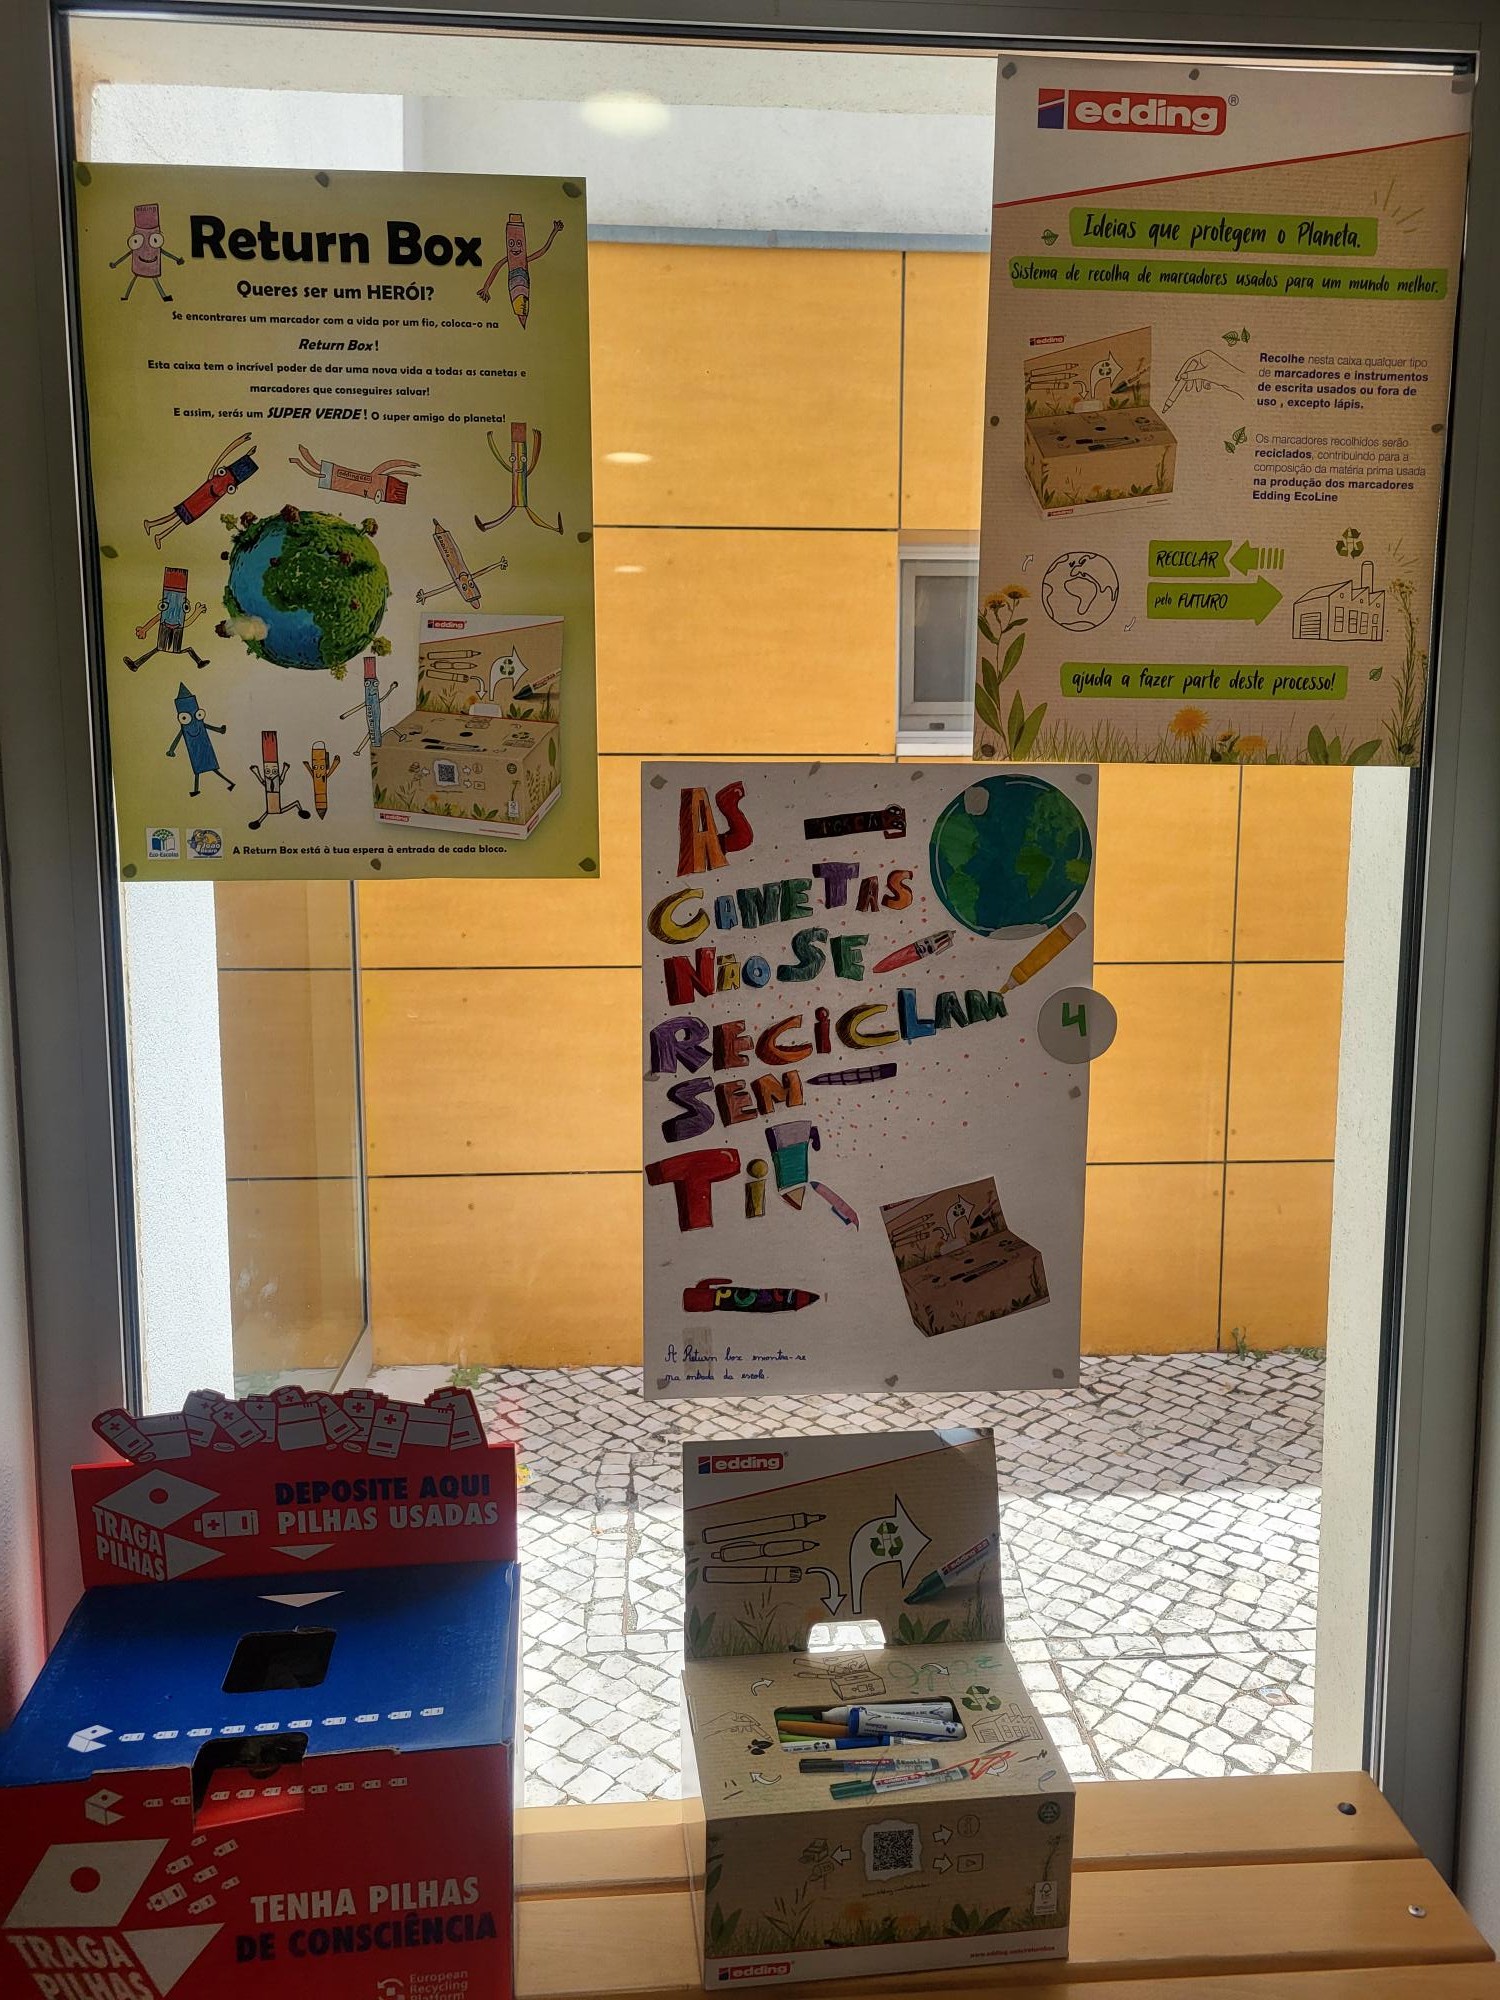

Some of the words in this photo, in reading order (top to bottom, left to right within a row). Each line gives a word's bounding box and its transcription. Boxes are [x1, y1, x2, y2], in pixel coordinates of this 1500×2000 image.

[1074, 97, 1218, 133] edding
[190, 215, 370, 263] Return
[386, 220, 483, 267] Box
[1083, 212, 1137, 239] Ideias
[1148, 224, 1180, 246] que
[1190, 223, 1267, 252] protegem
[1277, 231, 1286, 245] o
[1297, 221, 1361, 248] Planeta.
[1010, 262, 1058, 281] Sistema
[1065, 263, 1079, 281] de
[1087, 264, 1130, 283] recolha
[1137, 265, 1151, 284] de
[1159, 266, 1228, 286] marcadores
[1235, 269, 1278, 288] usados
[1284, 273, 1314, 293] para
[1321, 274, 1341, 290] um
[1348, 272, 1390, 292] mundo
[1396, 272, 1439, 294] melhor.
[236, 280, 298, 299] Queres
[303, 286, 328, 298] ser
[333, 288, 361, 299] um
[367, 281, 434, 301] HERÓI?
[172, 311, 183, 321] Se
[186, 312, 247, 323] encontrares
[250, 314, 267, 323] um
[270, 313, 320, 325] marcador
[323, 317, 344, 326] com
[356, 316, 380, 326] vida
[382, 318, 400, 330] por
[402, 319, 419, 327] um
[422, 317, 438, 329] fio,
[441, 318, 483, 329] coloca-o
[486, 320, 499, 329] na
[298, 338, 344, 351] Return
[347, 340, 379, 351] Box!
[147, 360, 170, 371] Esta
[173, 361, 201, 371] caixa
[203, 362, 224, 371] tem
[236, 361, 273, 373] incrível
[276, 363, 307, 375] poder
[309, 363, 323, 374] de
[325, 364, 343, 374] dar
[345, 366, 369, 375] uma
[372, 367, 397, 375] nova
[400, 365, 423, 376] vida
[435, 366, 463, 376] todas
[466, 368, 477, 377] as
[479, 368, 518, 377] canetas
[1260, 352, 1305, 364] Recolhe
[1308, 355, 1335, 365] nesta
[1337, 356, 1362, 366] caixa
[1364, 357, 1407, 370] qualquer
[1410, 358, 1428, 370] tipo
[1259, 368, 1271, 377] de
[1274, 369, 1341, 380] marcadores
[1354, 371, 1429, 381] instrumentos
[249, 384, 310, 394] marcadores
[312, 386, 333, 397] que
[335, 386, 393, 397] conseguires
[396, 386, 430, 396] salvar!
[1258, 383, 1272, 392] de
[1275, 383, 1313, 394] escrita
[1316, 385, 1357, 395] usados
[1360, 387, 1374, 396] ou
[1377, 385, 1400, 396] fora
[1403, 387, 1417, 396] de
[1257, 398, 1277, 406] uso
[1287, 398, 1331, 410] excepto
[1334, 398, 1364, 411] lápis.
[173, 407, 180, 417] E
[183, 408, 215, 419] assim,
[218, 408, 244, 418] serás
[246, 410, 264, 419] um
[267, 407, 311, 420] SUPER
[315, 408, 367, 420] VERDE!
[371, 411, 380, 420] O
[383, 412, 410, 424] super
[413, 412, 445, 423] amigo
[448, 412, 461, 423] do
[464, 412, 506, 424] planeta!
[1255, 433, 1270, 444] Os
[1272, 435, 1328, 446] marcadores
[1330, 436, 1379, 447] recolhidos
[1382, 438, 1409, 448] serão
[1255, 448, 1314, 460] reciclados,
[1317, 450, 1376, 461] contribuindo
[1378, 453, 1400, 463] para
[1253, 463, 1312, 475] composição
[1330, 464, 1364, 476] matéria
[1366, 466, 1394, 478] prima
[1397, 466, 1426, 477] usada
[1270, 477, 1322, 489] produção
[1325, 479, 1345, 488] dos
[1348, 479, 1414, 489] marcadores
[1252, 490, 1291, 502] Edding
[1294, 491, 1338, 502] EcoLine
[1155, 549, 1220, 569] RECICLAR
[1153, 593, 1173, 608] pelo
[1177, 592, 1229, 611] FUTURO
[1071, 669, 1112, 694] ajuda
[1121, 674, 1131, 688] a
[1139, 670, 1175, 691] fazer
[1183, 673, 1220, 695] parte
[1229, 671, 1265, 691] deste
[1271, 672, 1336, 695] processo!
[677, 780, 754, 878] AS
[232, 846, 241, 855] A
[243, 846, 277, 855] Return
[279, 846, 298, 855] Box
[300, 845, 321, 855] está
[333, 846, 350, 854] tua
[352, 846, 385, 855] espera
[396, 845, 436, 854] entrada
[438, 845, 450, 854] de
[453, 845, 476, 854] cada
[478, 845, 507, 854] bloco.
[647, 861, 914, 945] CANETAS
[776, 927, 870, 982] SE
[1061, 1002, 1087, 1037] 4
[661, 1069, 804, 1144] SEM
[683, 1343, 718, 1360] Return
[715, 1456, 779, 1471] edding
[275, 1477, 408, 1506] DEPOSITE
[420, 1474, 490, 1501] AQUI
[277, 1505, 378, 1535] PILHAS
[389, 1502, 498, 1530] USADAS
[91, 1506, 164, 1557] TRAGA
[95, 1534, 166, 1582] PILHAS
[251, 1886, 357, 1924] TENHA
[369, 1876, 481, 1913] PILHAS
[236, 1934, 277, 1963] DE
[288, 1911, 497, 1958] CONSCIÊNCIA
[6, 1935, 130, 1971] TRAGA
[409, 1970, 469, 1985] European
[732, 1963, 788, 1979] edding
[31, 1970, 155, 2000] PILHAS
[409, 1979, 469, 1994] Recycling
